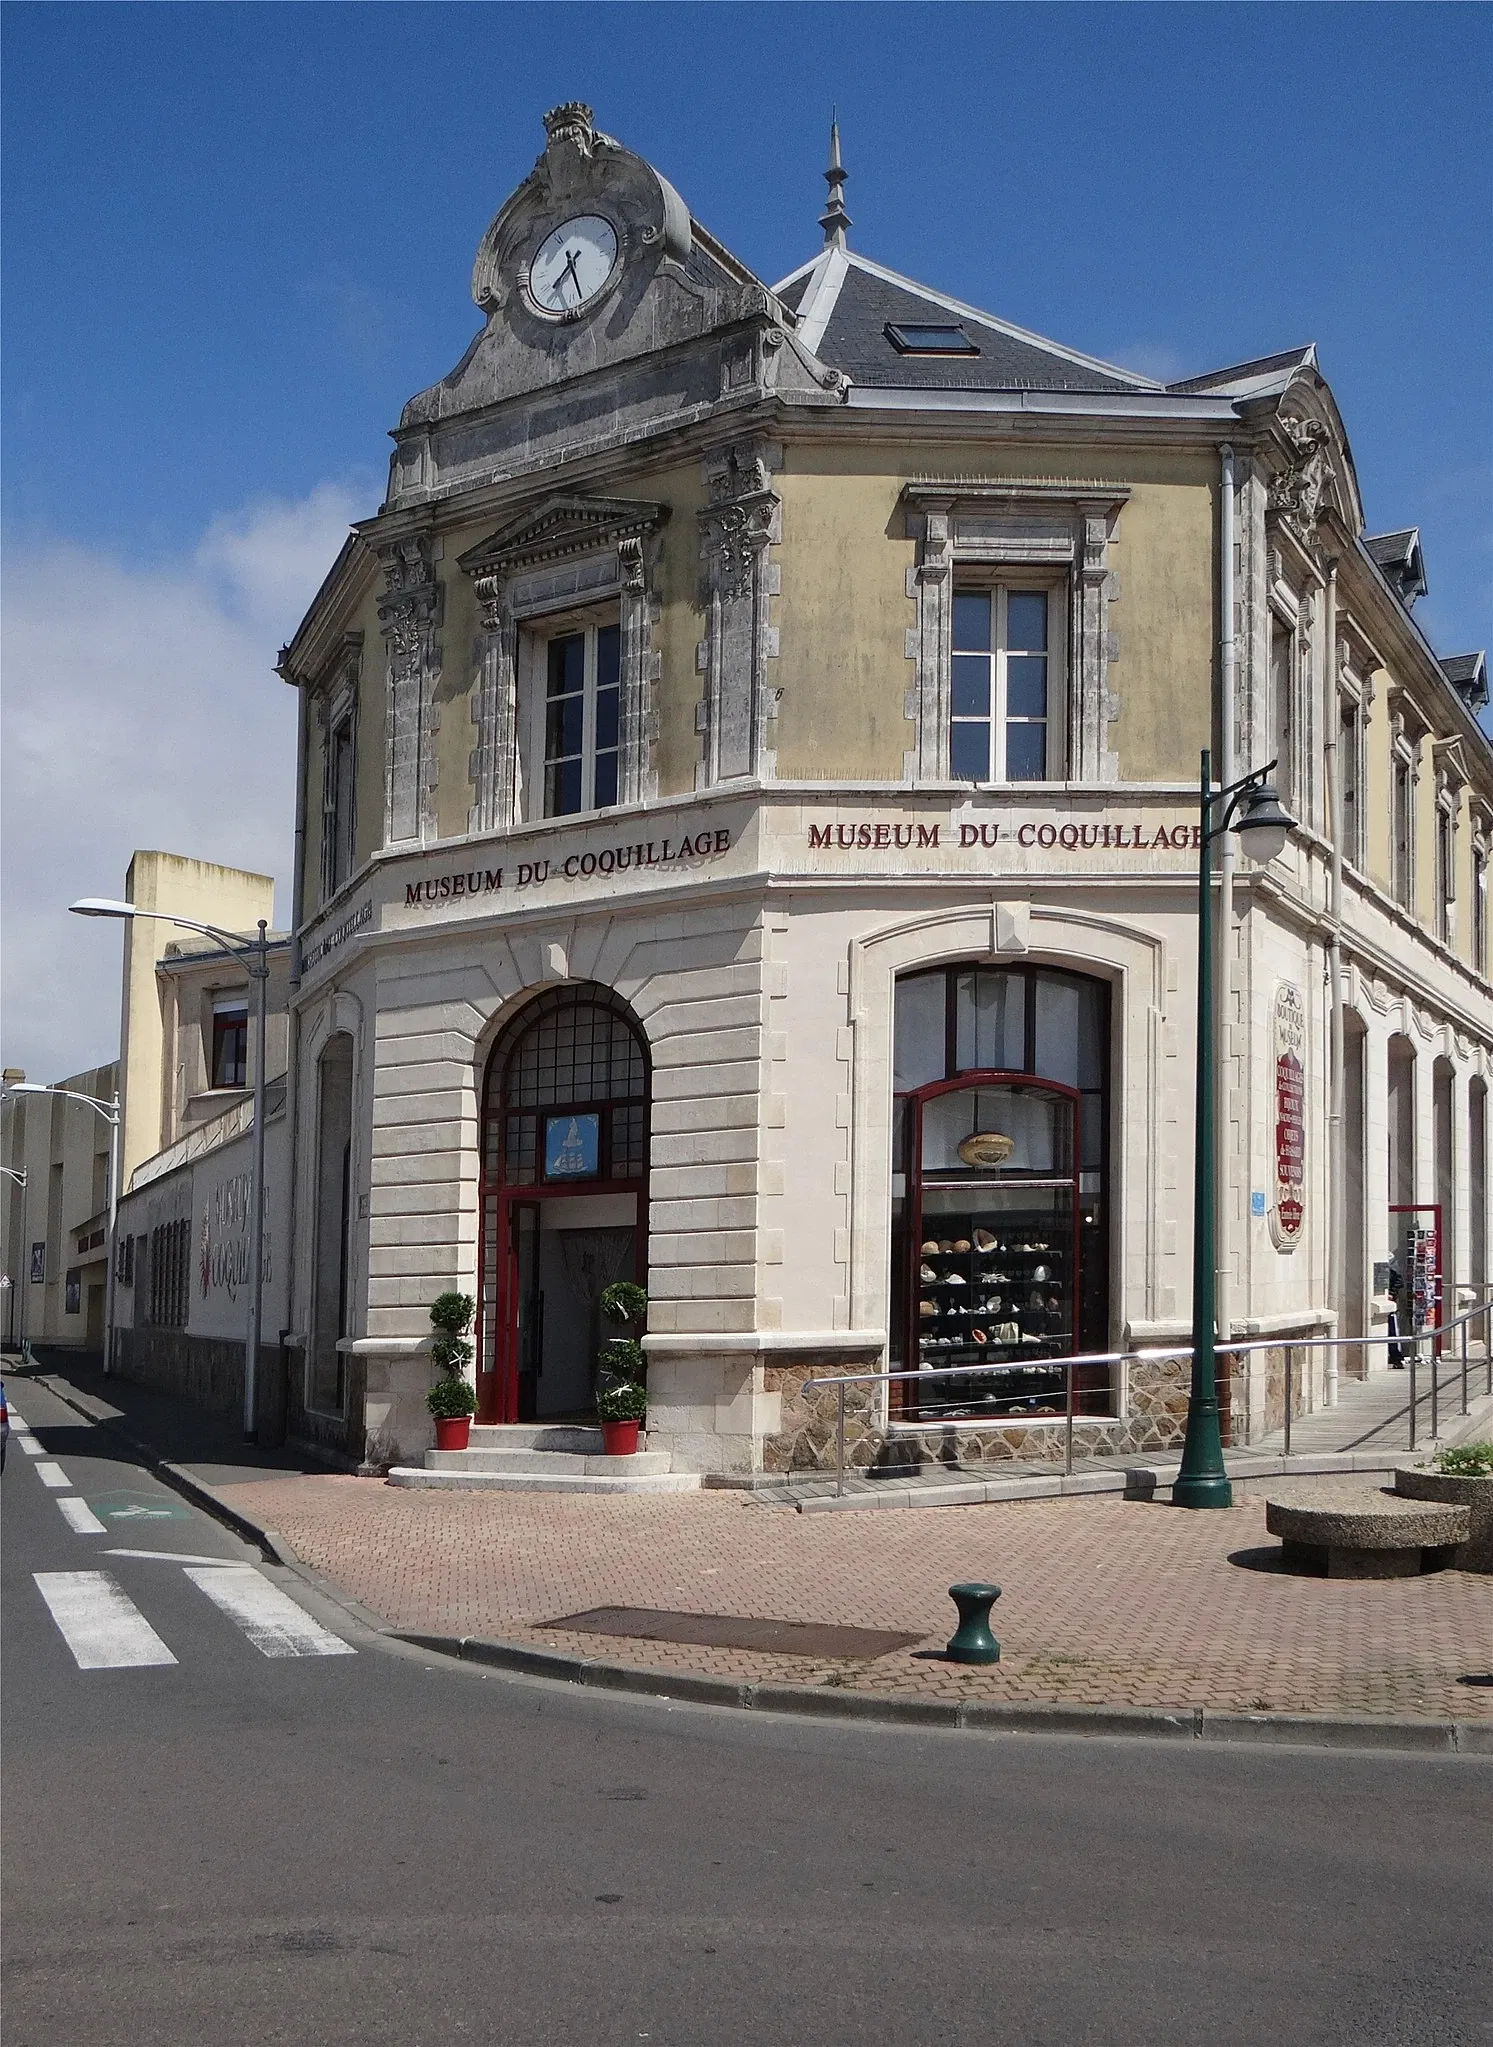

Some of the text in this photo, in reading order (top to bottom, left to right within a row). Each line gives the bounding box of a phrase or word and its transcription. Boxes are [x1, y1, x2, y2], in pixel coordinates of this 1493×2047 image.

[808, 824, 941, 849] MUSEUM
[957, 824, 1000, 848] DU
[405, 829, 731, 904] MUSEUM DU COQUILLAGE
